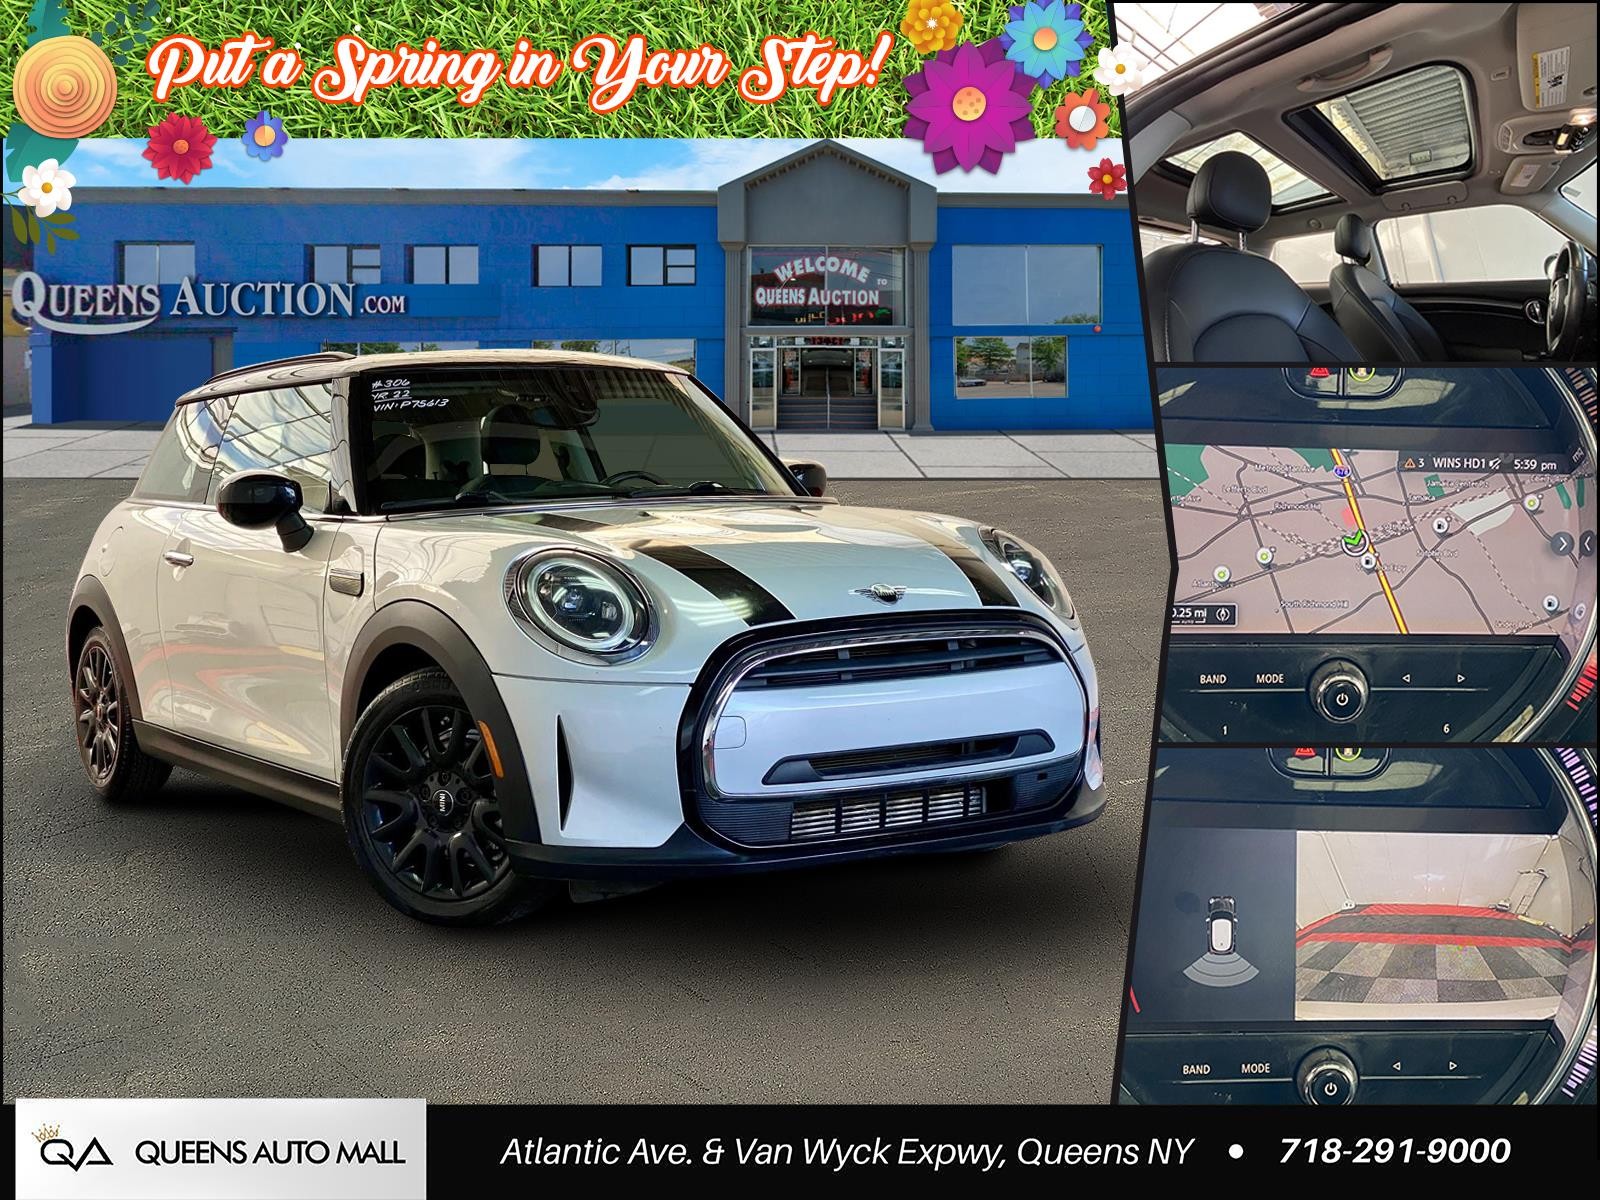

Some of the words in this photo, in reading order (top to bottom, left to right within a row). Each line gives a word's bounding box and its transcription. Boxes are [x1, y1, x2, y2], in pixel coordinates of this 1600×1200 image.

[773, 255, 872, 284] WELCOME
[876, 277, 889, 286] TO
[755, 286, 807, 307] QUEENS
[808, 287, 881, 306] AUCTION
[12, 271, 162, 335] QUEENS
[371, 378, 411, 390] #306
[392, 389, 411, 399] 22
[400, 398, 449, 409] P75613
[1418, 458, 1425, 468] 3
[1432, 457, 1462, 469] WINS
[1463, 457, 1486, 469] HD1
[1513, 458, 1538, 470] 5:39
[1541, 462, 1557, 472] pm
[1194, 608, 1207, 618] mi
[1199, 674, 1227, 684] BAND
[1256, 673, 1285, 684] MODE
[1223, 725, 1228, 735] 1
[1442, 723, 1450, 734] 6
[1182, 1064, 1211, 1075] BAND
[1241, 1063, 1271, 1074] MODE
